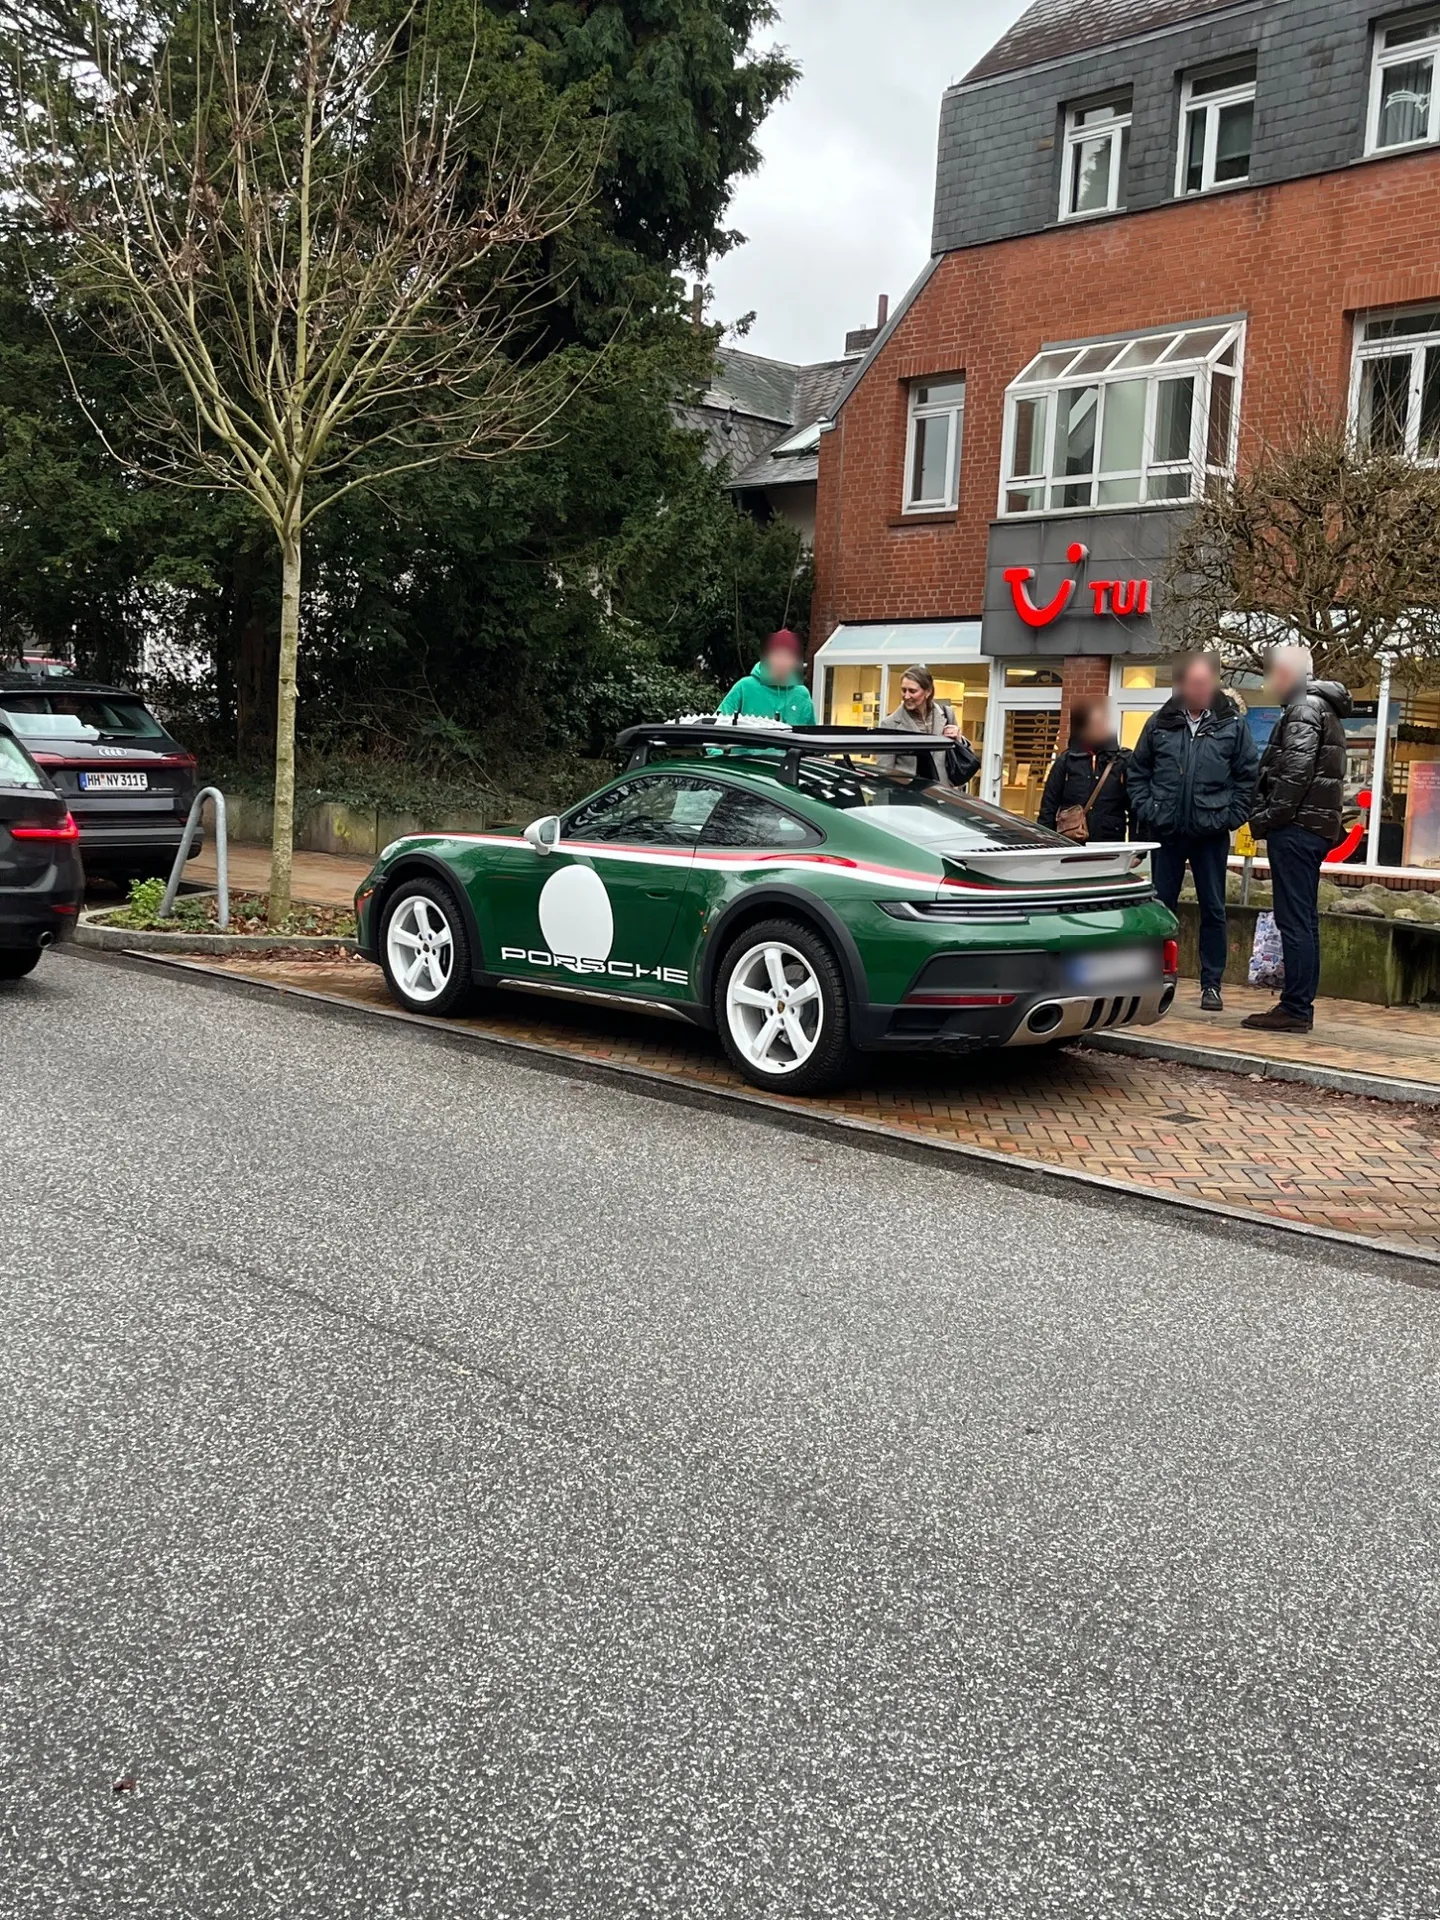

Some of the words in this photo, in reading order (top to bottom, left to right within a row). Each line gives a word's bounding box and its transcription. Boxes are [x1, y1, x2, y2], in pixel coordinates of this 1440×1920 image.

[1088, 578, 1152, 616] TUI
[88, 774, 101, 786] HH
[501, 946, 689, 985] PORSCHE
